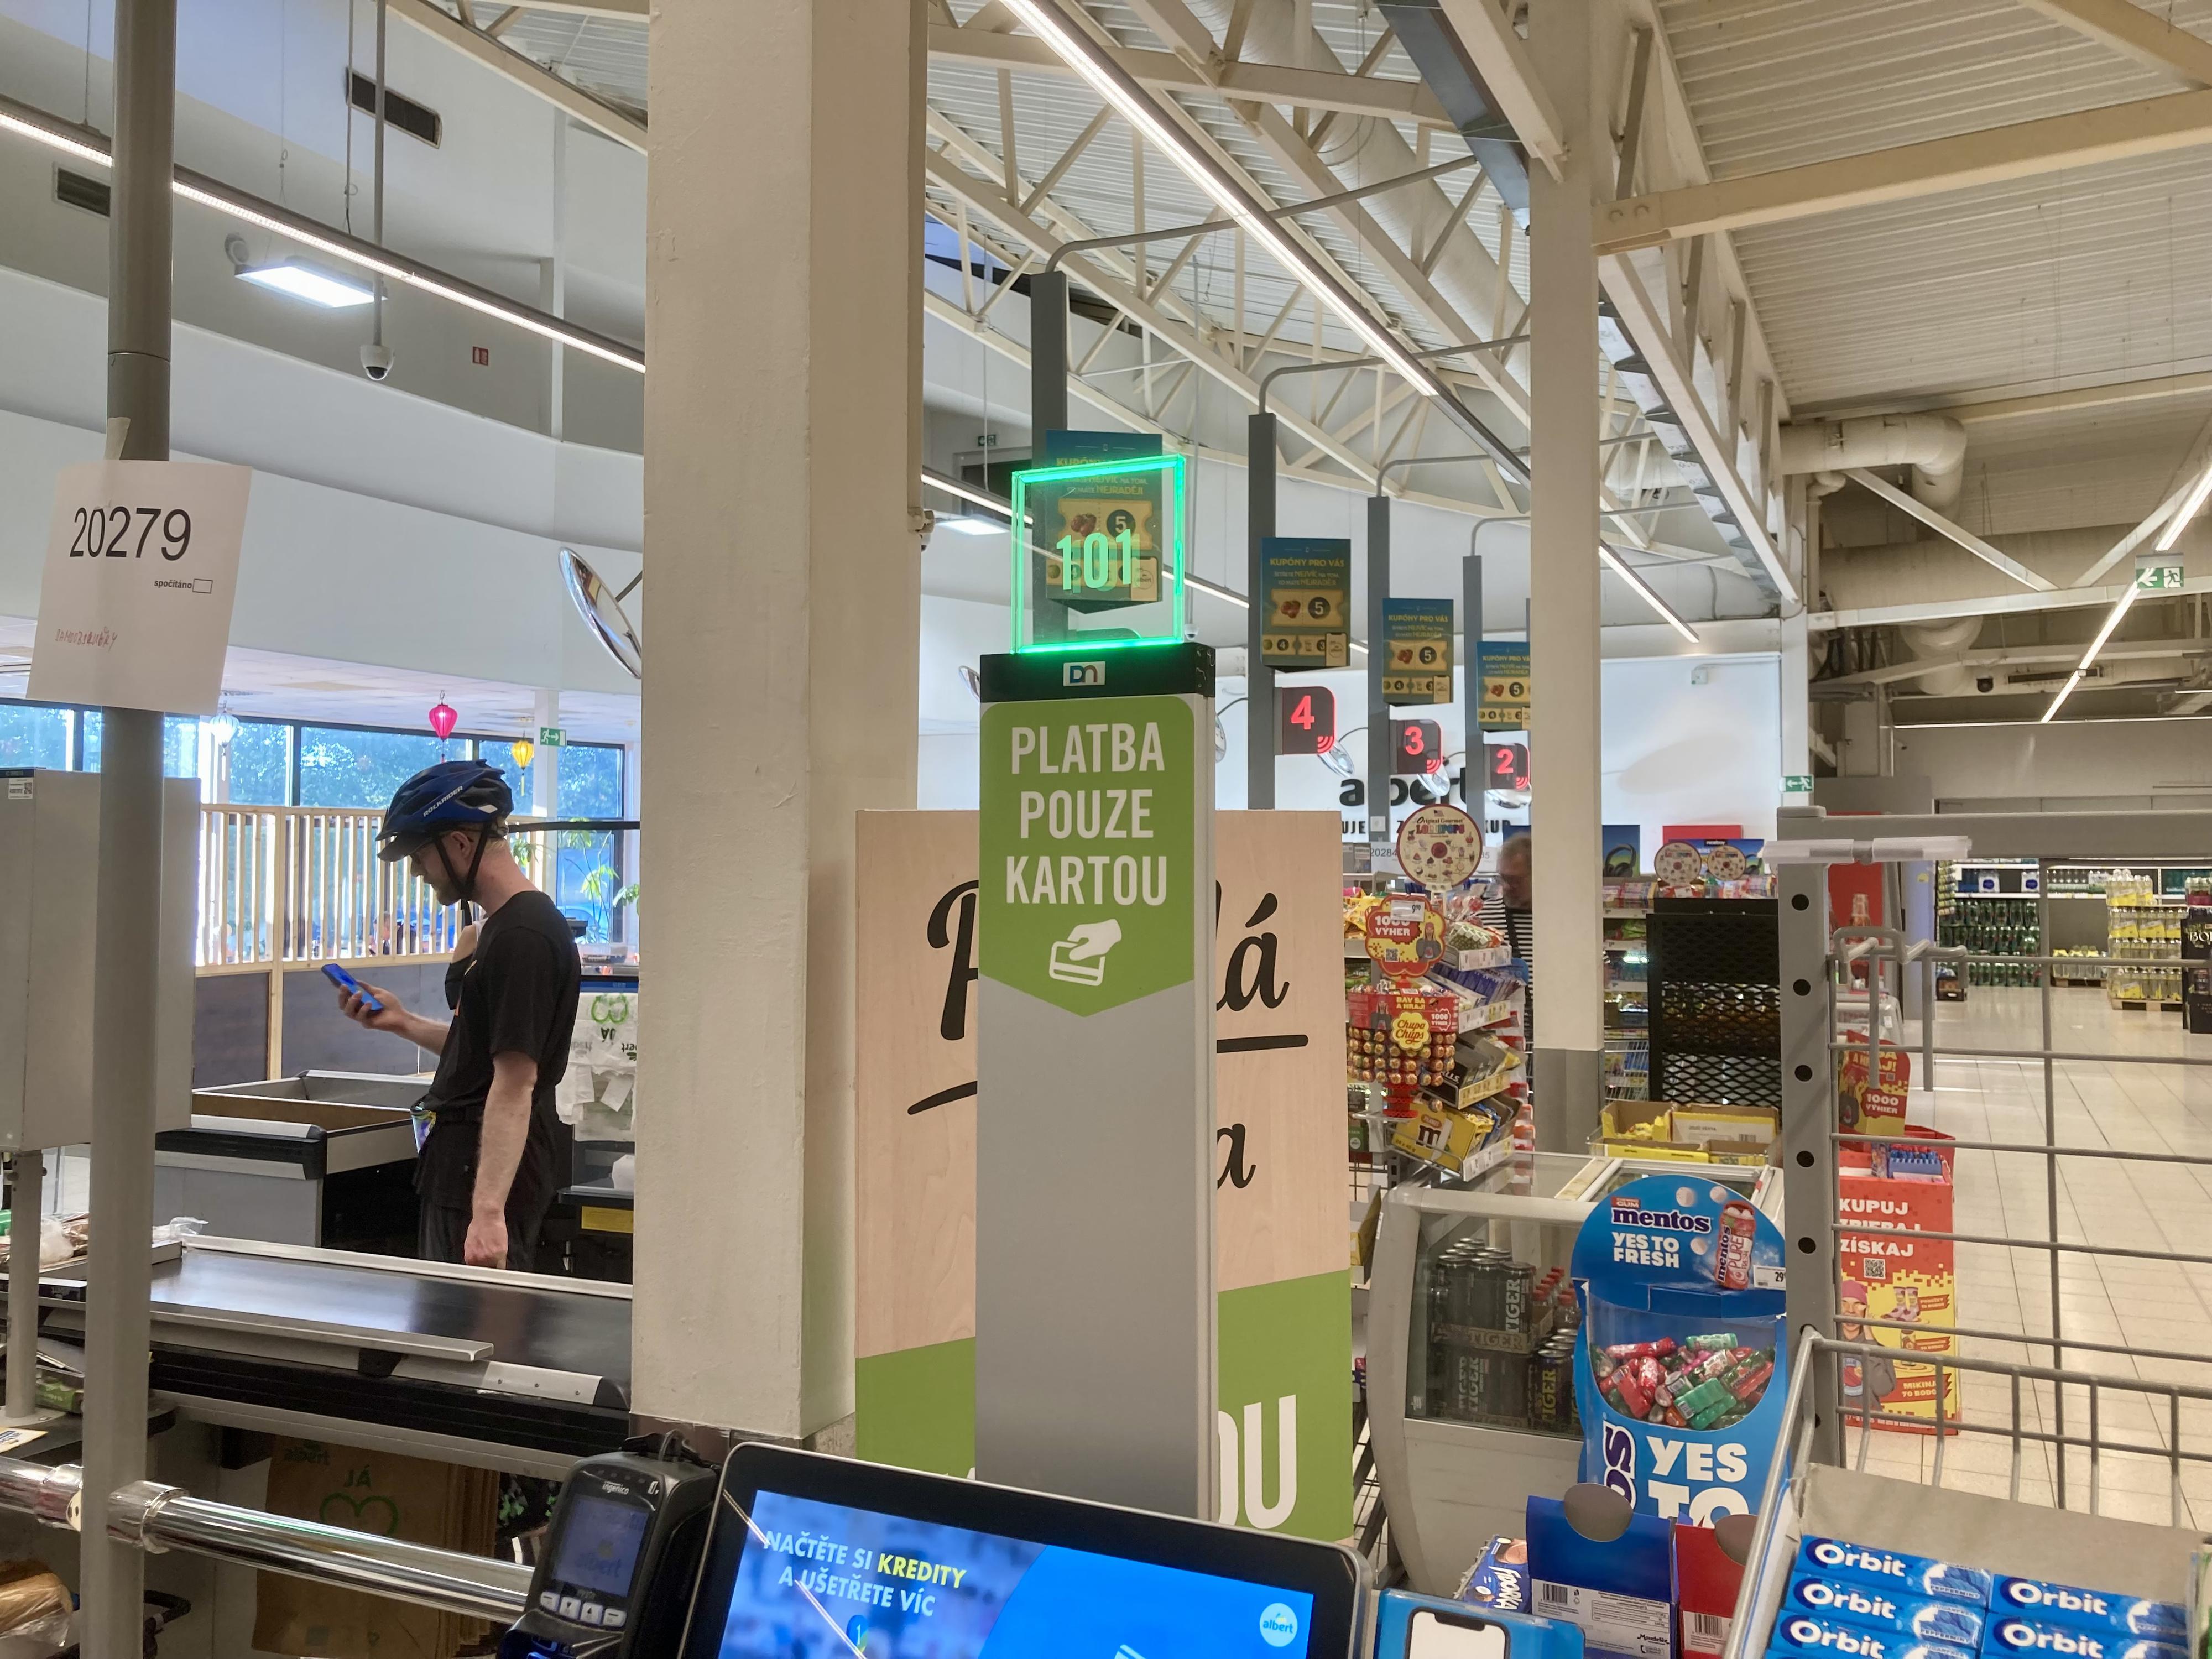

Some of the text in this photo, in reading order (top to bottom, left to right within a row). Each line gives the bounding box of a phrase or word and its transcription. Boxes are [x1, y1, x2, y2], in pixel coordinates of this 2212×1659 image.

[70, 506, 191, 561] 20279
[1115, 516, 1127, 533] 5
[1056, 528, 1131, 591] 101
[1270, 557, 1307, 566] KUPÓNY
[1328, 558, 1344, 567] VÁS
[154, 578, 192, 589] spočítáno
[1314, 602, 1323, 615] 5
[1279, 641, 1285, 649] 4
[1424, 650, 1432, 661] 5
[1513, 685, 1520, 695] 5
[1291, 695, 1314, 730] 4
[1011, 722, 1165, 774] PLATBA
[1405, 726, 1425, 755] 3
[1496, 749, 1514, 774] 2
[423, 785, 463, 817] ROCKRIDER
[1021, 789, 1154, 839] POUZE
[1005, 855, 1168, 906] KARTOU
[1375, 926, 1411, 936] VÝHER
[1395, 1029, 1424, 1044] Chups
[1397, 1019, 1426, 1030] Chupa
[1866, 1093, 1899, 1105] 1000
[1839, 1198, 1908, 1215] KUPUJ
[1612, 1207, 1712, 1233] mentos
[1611, 1231, 1679, 1253] YES TO
[1718, 1224, 1732, 1282] mentos
[1728, 1237, 1745, 1269] PURE
[1840, 1236, 1914, 1257] ZÍSKAJ
[1613, 1246, 1679, 1268] FRESH
[1506, 1279, 1521, 1333] TIGER
[1469, 1329, 1521, 1350] TIGER
[1646, 1436, 1748, 1483] YES
[343, 1465, 372, 1488] JÁ
[602, 1481, 629, 1495] ingenico
[1648, 1480, 1750, 1529] TO
[764, 1530, 967, 1589] NAČTĚTE SI KREDITY
[1814, 1540, 1906, 1577] Orbit
[778, 1566, 936, 1616] A UŠETŘETE VÍC
[1803, 1582, 1897, 1619] Orbit
[1930, 1585, 1980, 1599] PEPPERMINT
[2010, 1582, 2108, 1615] Orbit
[1262, 1619, 1293, 1634] albert
[1920, 1629, 1972, 1644] PEPPERMINT
[1790, 1620, 1885, 1659] Orbit
[2003, 1623, 2104, 1658] Orbit
